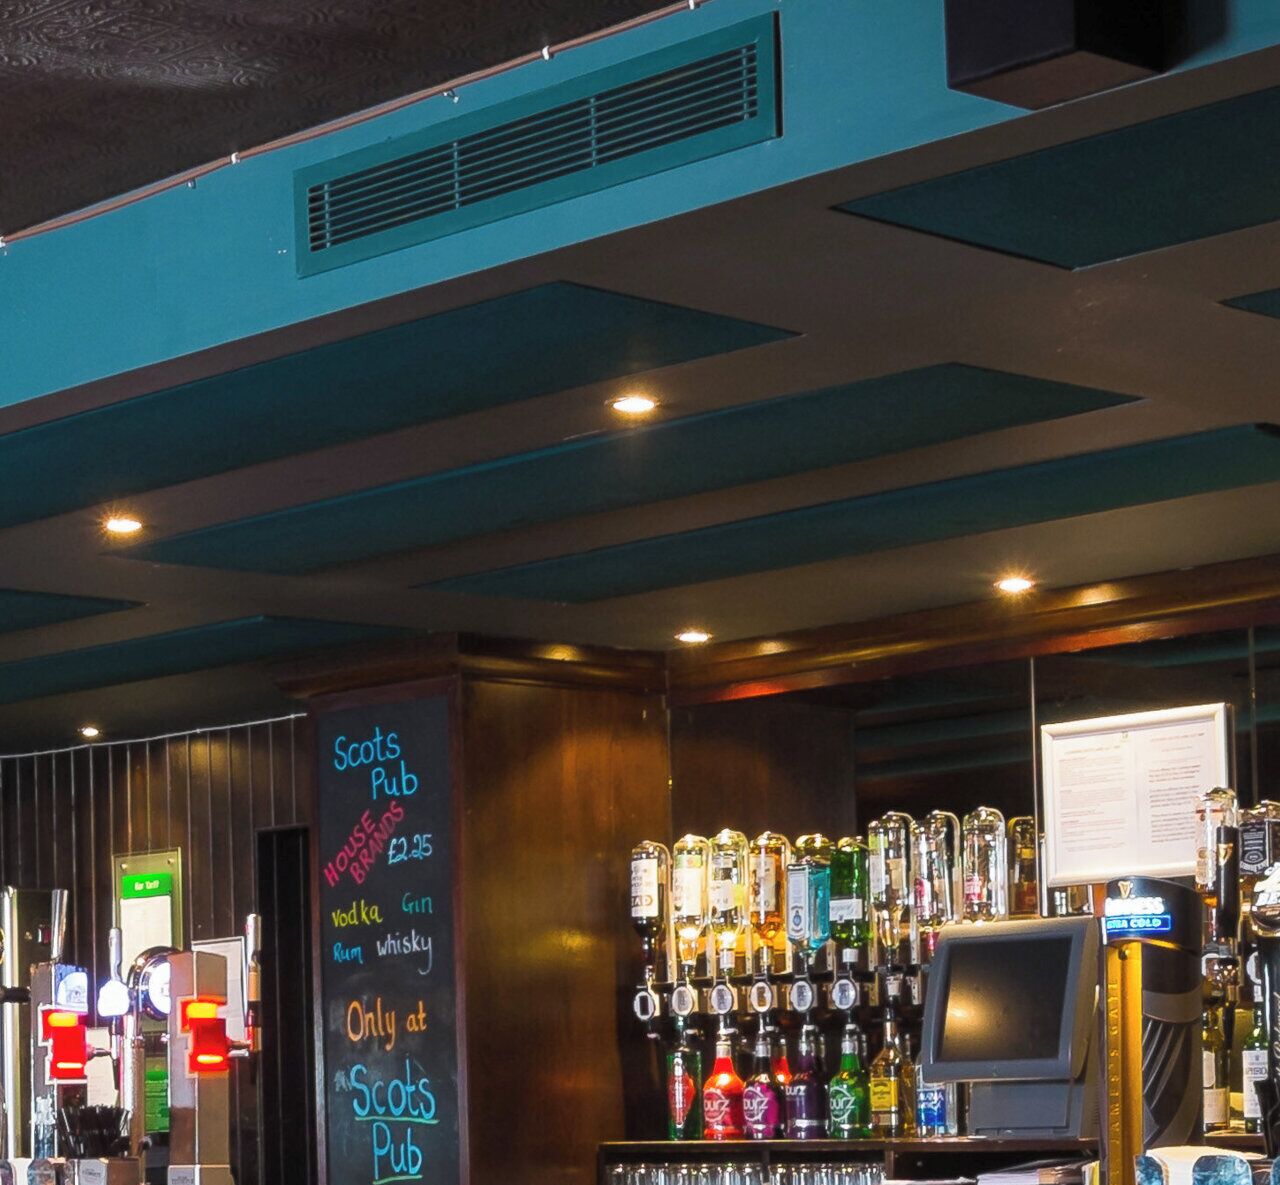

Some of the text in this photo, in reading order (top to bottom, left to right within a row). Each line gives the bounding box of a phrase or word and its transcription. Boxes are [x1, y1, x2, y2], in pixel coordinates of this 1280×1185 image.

[333, 726, 400, 770] Scots
[371, 759, 418, 800] Pub
[324, 809, 375, 887] HOUSE
[349, 800, 404, 885] BRANDS
[388, 834, 432, 865] £2.25
[333, 942, 363, 964] Rum
[347, 997, 428, 1051] Only at
[350, 1058, 435, 1119] Scots
[372, 1121, 422, 1180] Pub
